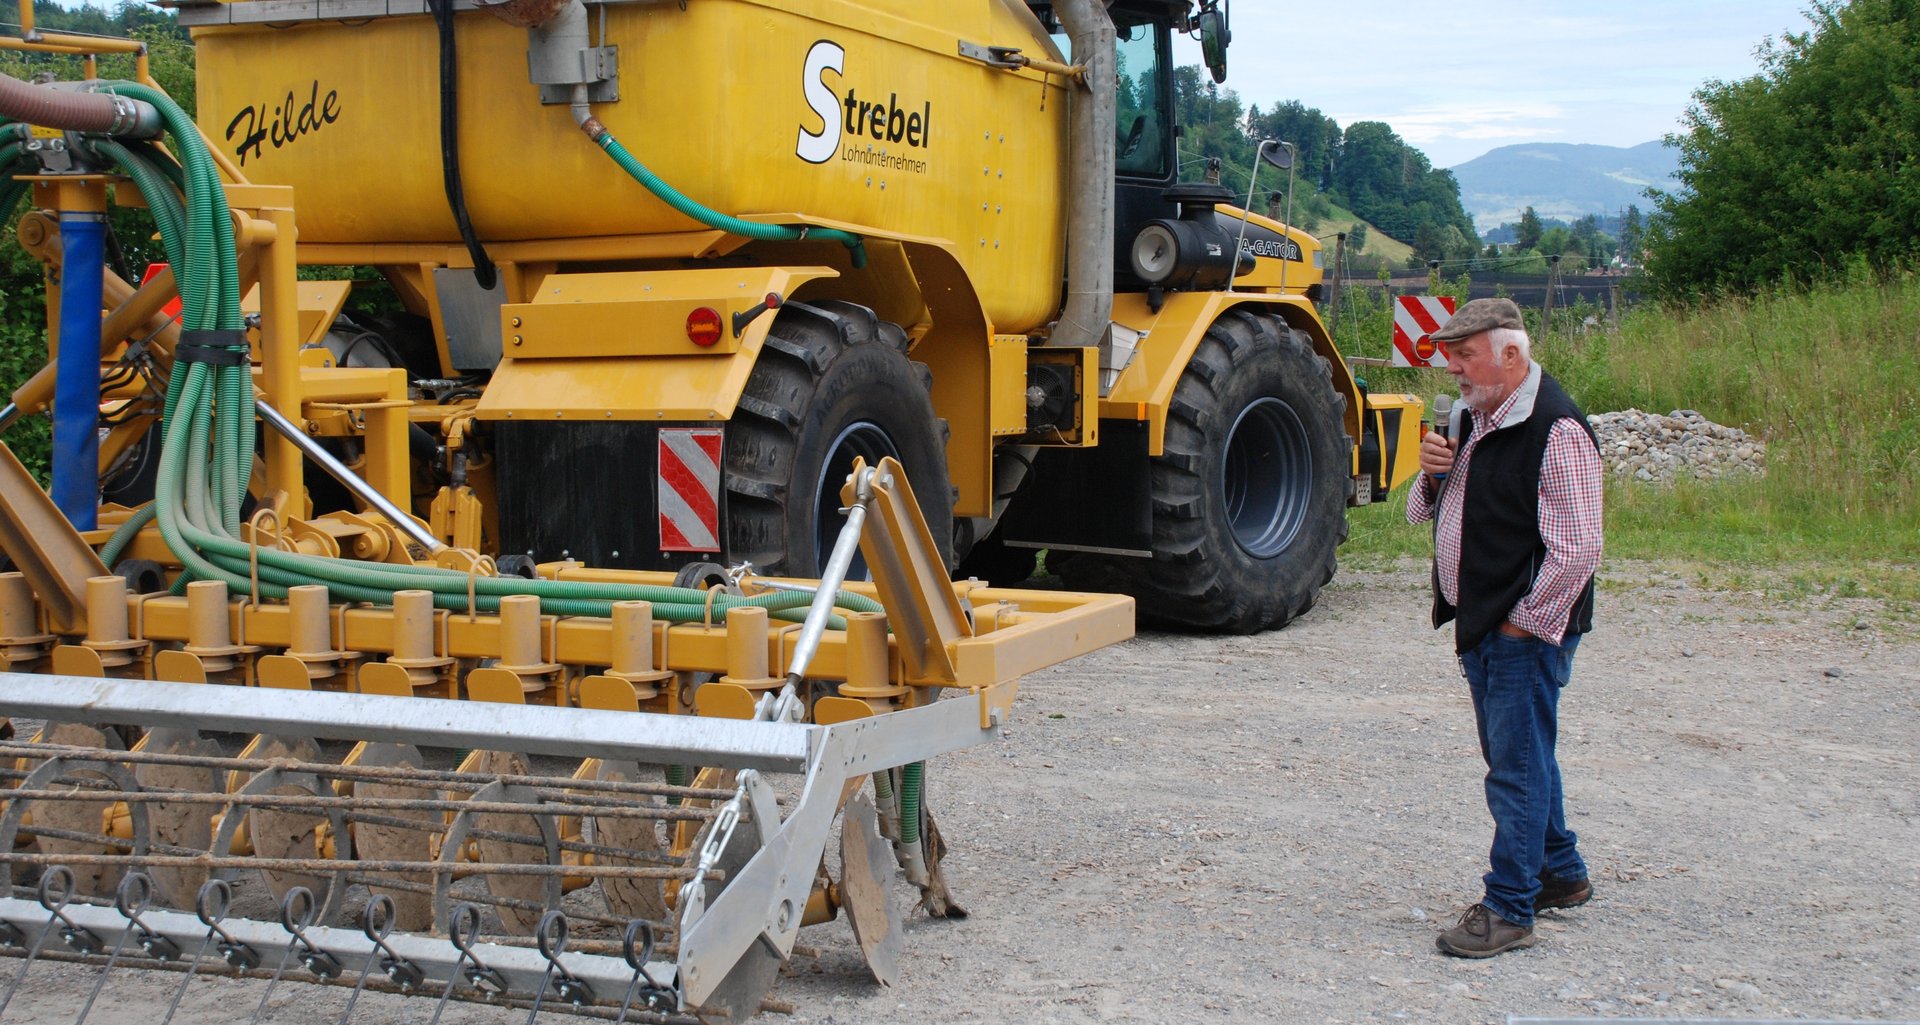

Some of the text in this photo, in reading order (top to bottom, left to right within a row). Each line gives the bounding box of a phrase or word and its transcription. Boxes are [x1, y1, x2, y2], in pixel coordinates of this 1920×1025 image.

[225, 79, 341, 167] Hilde
[795, 38, 931, 165] Strebel
[1235, 237, 1298, 260] A-GATOR
